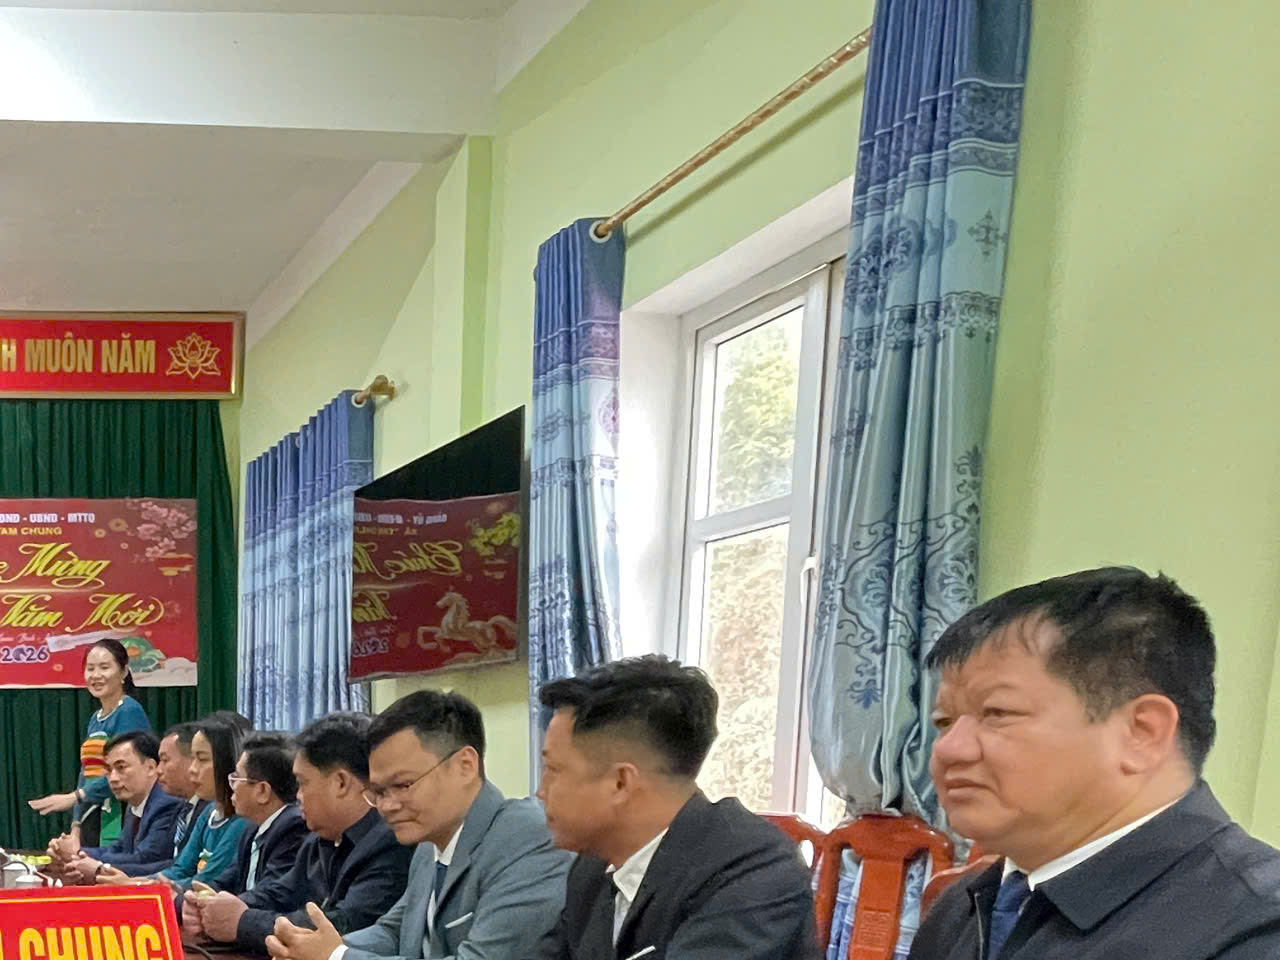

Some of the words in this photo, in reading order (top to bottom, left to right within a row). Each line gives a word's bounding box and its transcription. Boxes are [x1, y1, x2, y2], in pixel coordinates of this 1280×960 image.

[24, 331, 94, 373] MUÔN
[101, 332, 156, 373] NĂM
[21, 526, 62, 536] CHUNG
[65, 592, 165, 633] Mới
[0, 645, 50, 663] 2026
